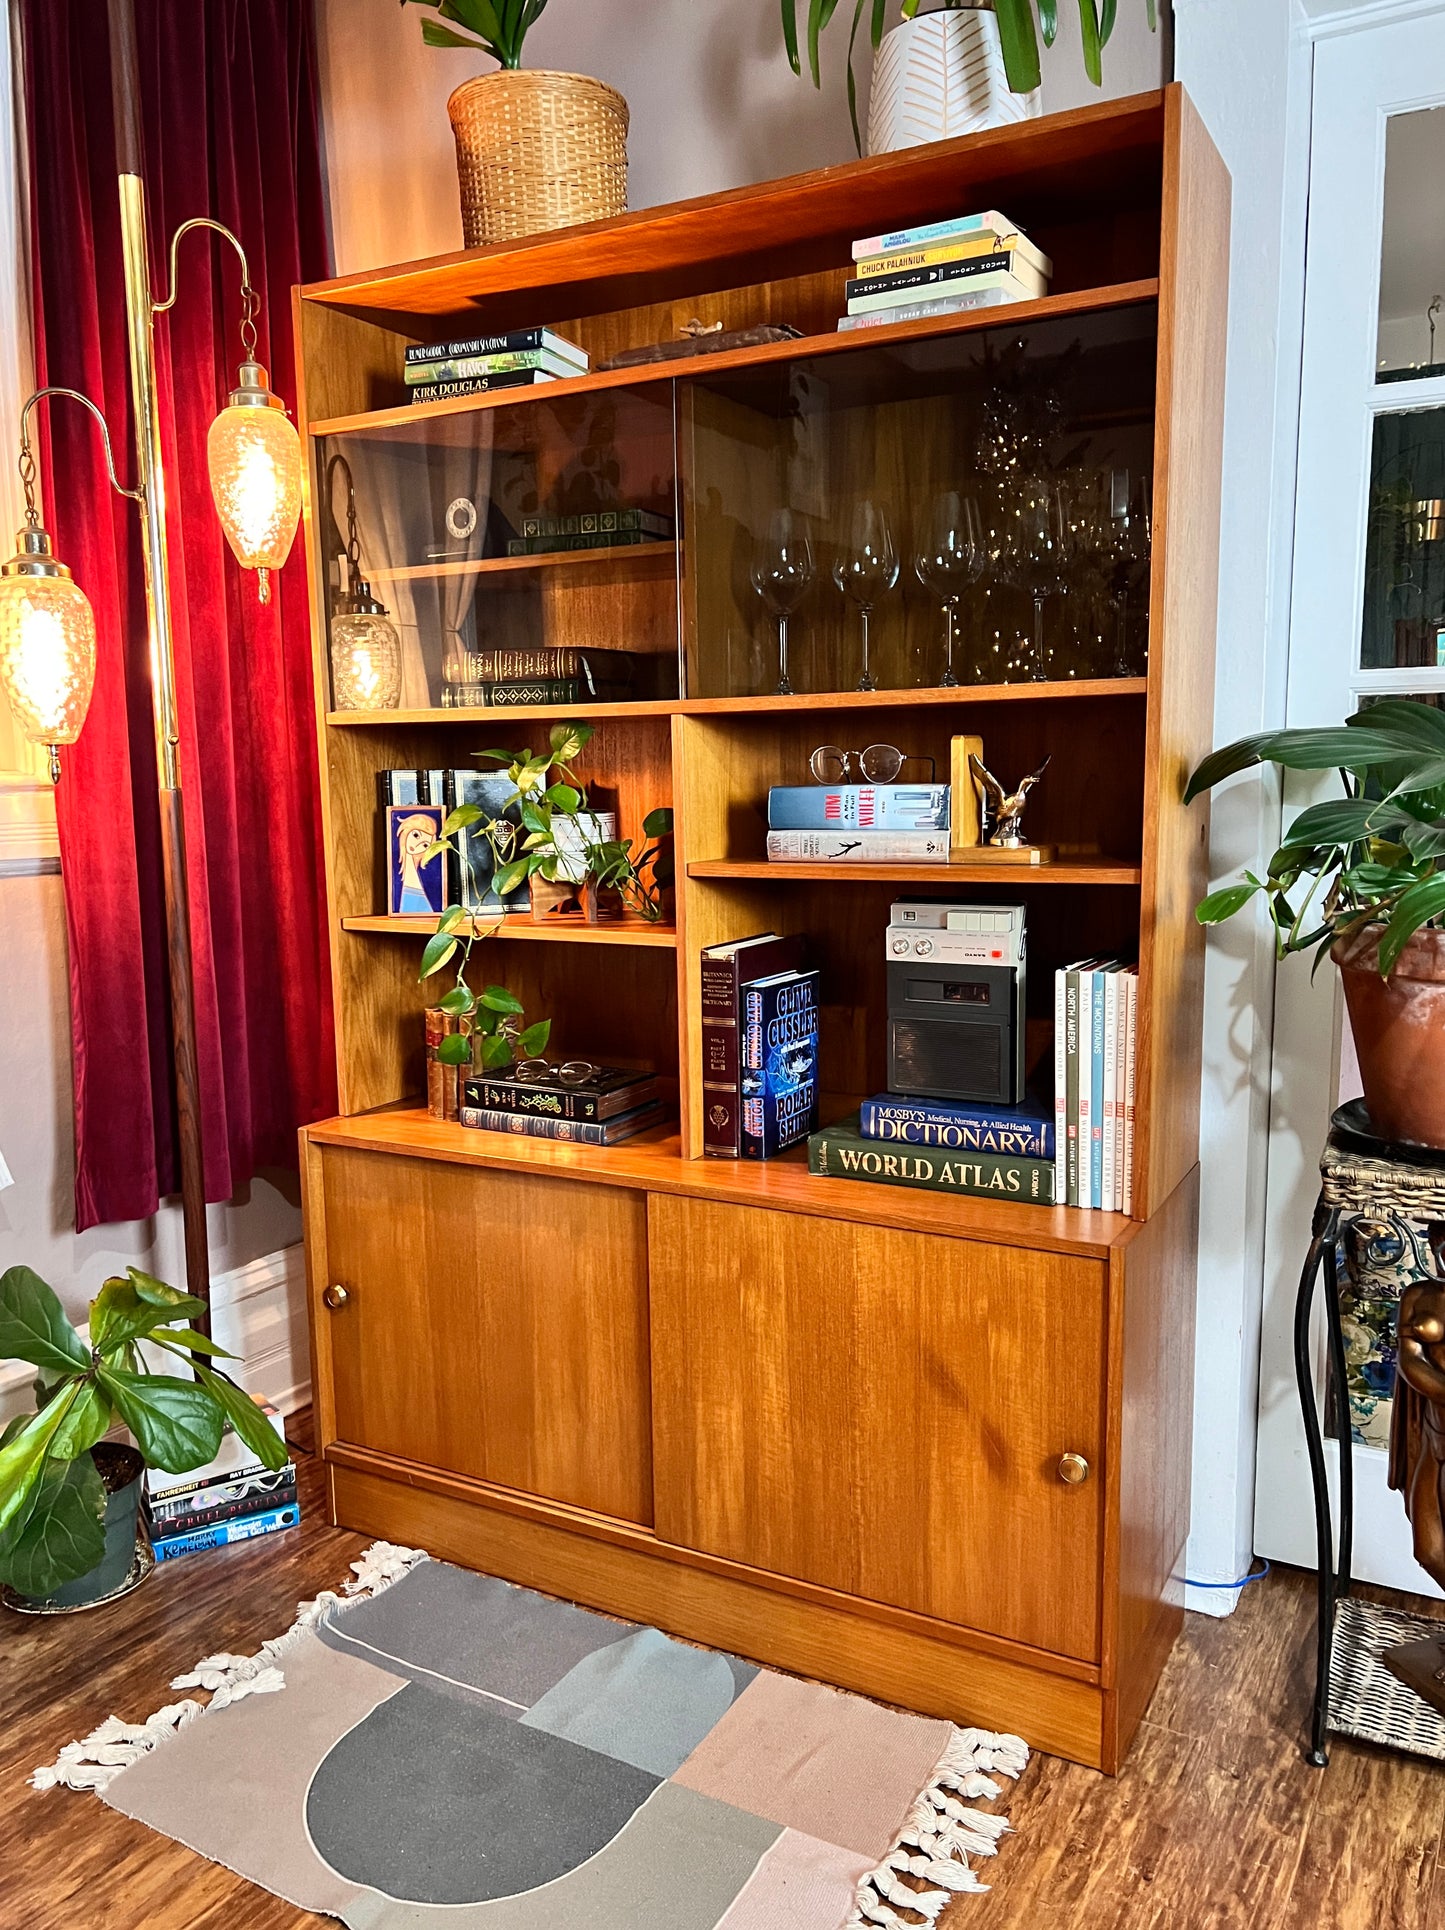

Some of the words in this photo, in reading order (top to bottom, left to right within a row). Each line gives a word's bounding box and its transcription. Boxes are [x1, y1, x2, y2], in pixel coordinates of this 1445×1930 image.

[884, 238, 912, 248] ANGELOU
[862, 262, 886, 274] CHUCK
[886, 254, 926, 270] PALAHNIUK
[950, 266, 976, 275] STORY
[980, 260, 1006, 270] HOUSE
[854, 283, 888, 293] TIMOTHY
[892, 276, 921, 286] TAYLOR
[457, 360, 492, 378] HAVOC
[412, 386, 438, 399] KIRK
[439, 378, 489, 395] DOUGLAS
[824, 794, 842, 821] TOM
[859, 788, 876, 827] WOLFE
[748, 993, 762, 1023] CLIVE
[777, 981, 812, 1018] CLIVE
[1068, 987, 1076, 1016] NORTH
[1094, 990, 1102, 1005] THE
[768, 1006, 818, 1049] CUSSLER
[1068, 1018, 1076, 1054] AMERICA
[1094, 1008, 1102, 1054] MOUNTAINS
[748, 1025, 762, 1069] CUSSLER
[752, 1098, 764, 1136] POLAR
[776, 1085, 813, 1122] POLAR
[1127, 1107, 1135, 1121] LIFE
[878, 1106, 926, 1122] MOSBY'S
[926, 1114, 954, 1125] Medical,
[954, 1117, 980, 1128] Nursing,
[982, 1120, 988, 1128] &
[989, 1120, 1009, 1130] Allied
[1010, 1123, 1032, 1132] Health
[878, 1118, 1035, 1156] DICTIONARY
[838, 1148, 934, 1181] WORLD
[938, 1161, 1021, 1192] ATLAS
[1032, 1169, 1040, 1198] HAMMOND
[230, 1470, 242, 1480] RAY
[156, 1482, 199, 1500] FAHRENHEIT
[172, 1510, 220, 1528] CRUEL
[188, 1530, 216, 1542] HARRY
